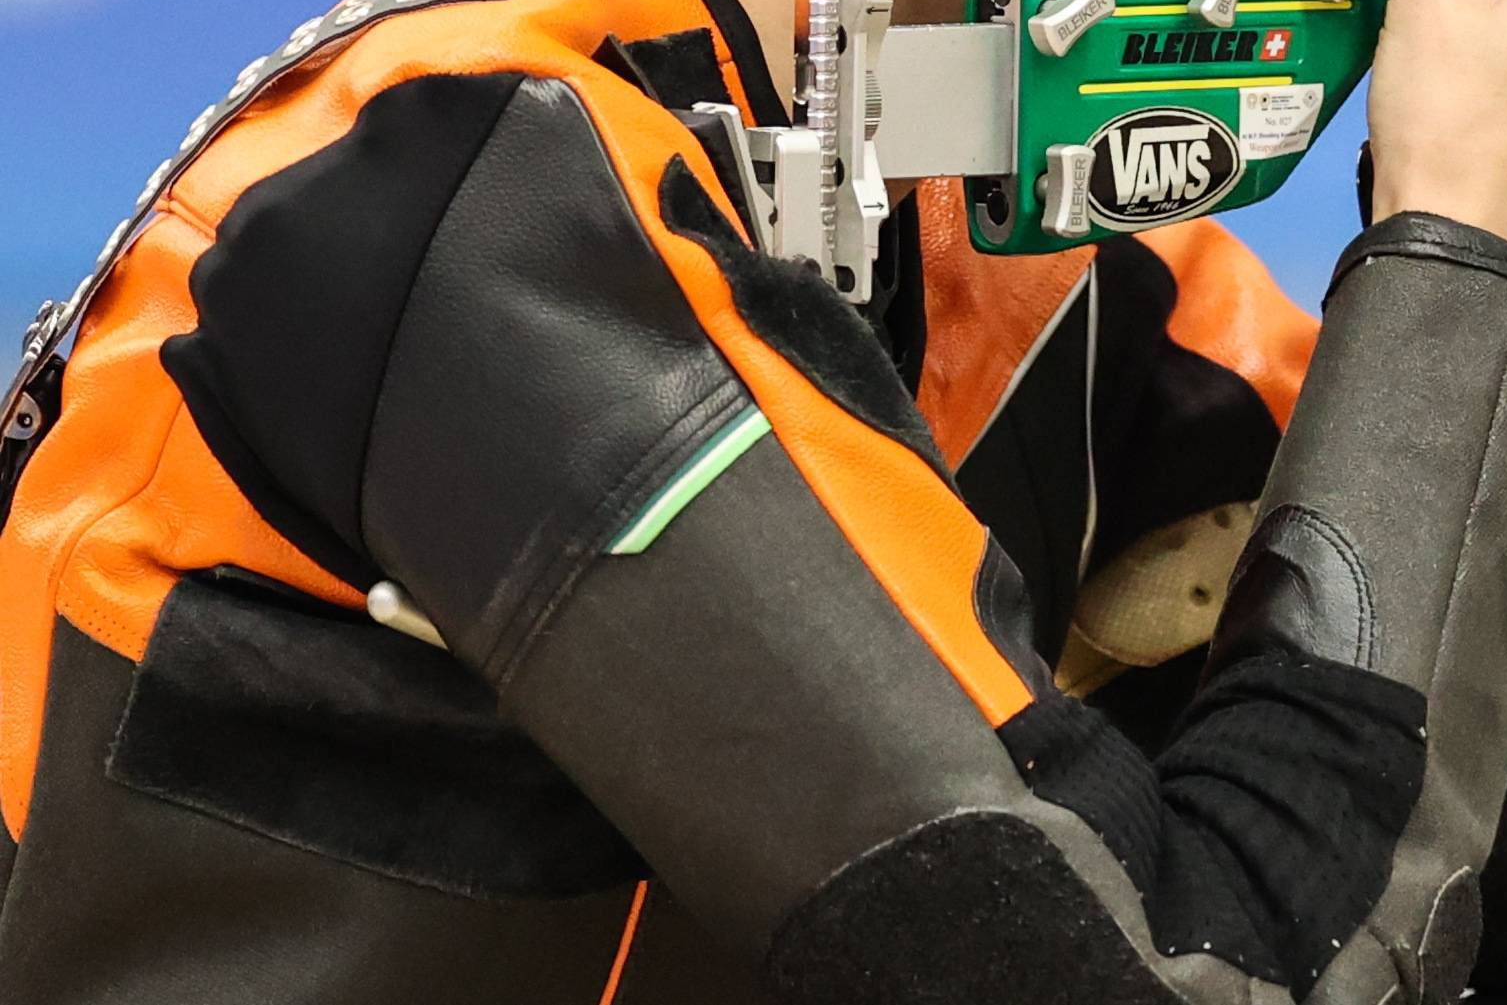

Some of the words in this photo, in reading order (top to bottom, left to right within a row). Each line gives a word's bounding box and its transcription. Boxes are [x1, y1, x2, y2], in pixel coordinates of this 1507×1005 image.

[1121, 30, 1259, 65] BLEIKER
[1070, 157, 1087, 227] BLEIKER
[1108, 123, 1212, 206] VANS
